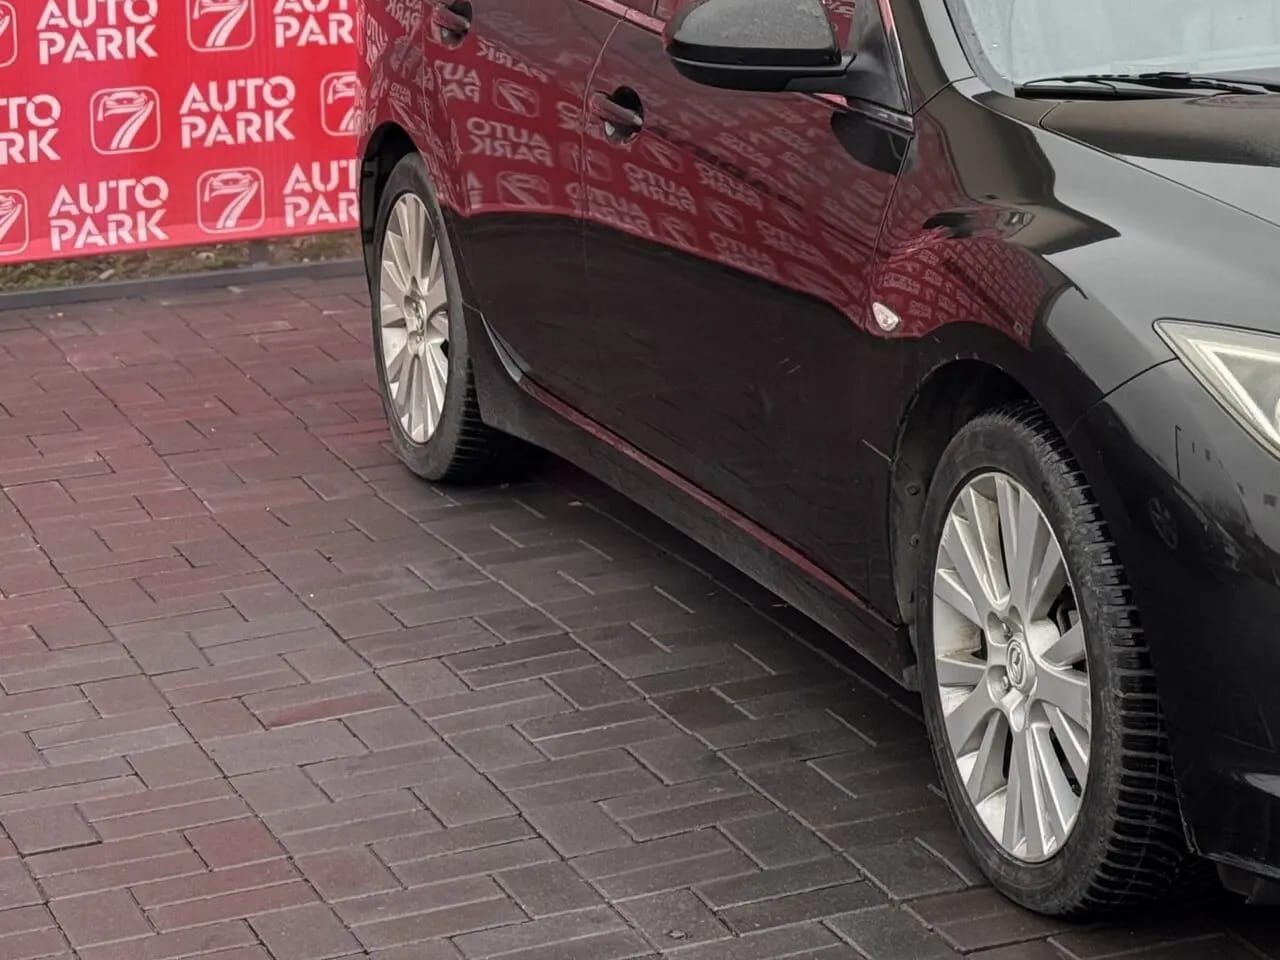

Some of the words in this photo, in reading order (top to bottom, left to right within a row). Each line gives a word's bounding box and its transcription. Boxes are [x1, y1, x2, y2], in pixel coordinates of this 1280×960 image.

[39, 26, 156, 64] PARK
[276, 14, 356, 49] PAR
[180, 77, 295, 113] AUTO
[182, 109, 293, 147] PARK
[284, 160, 357, 194] AUT
[49, 177, 168, 216] AUTO
[285, 193, 360, 229] PAR
[51, 210, 168, 250] PARK
